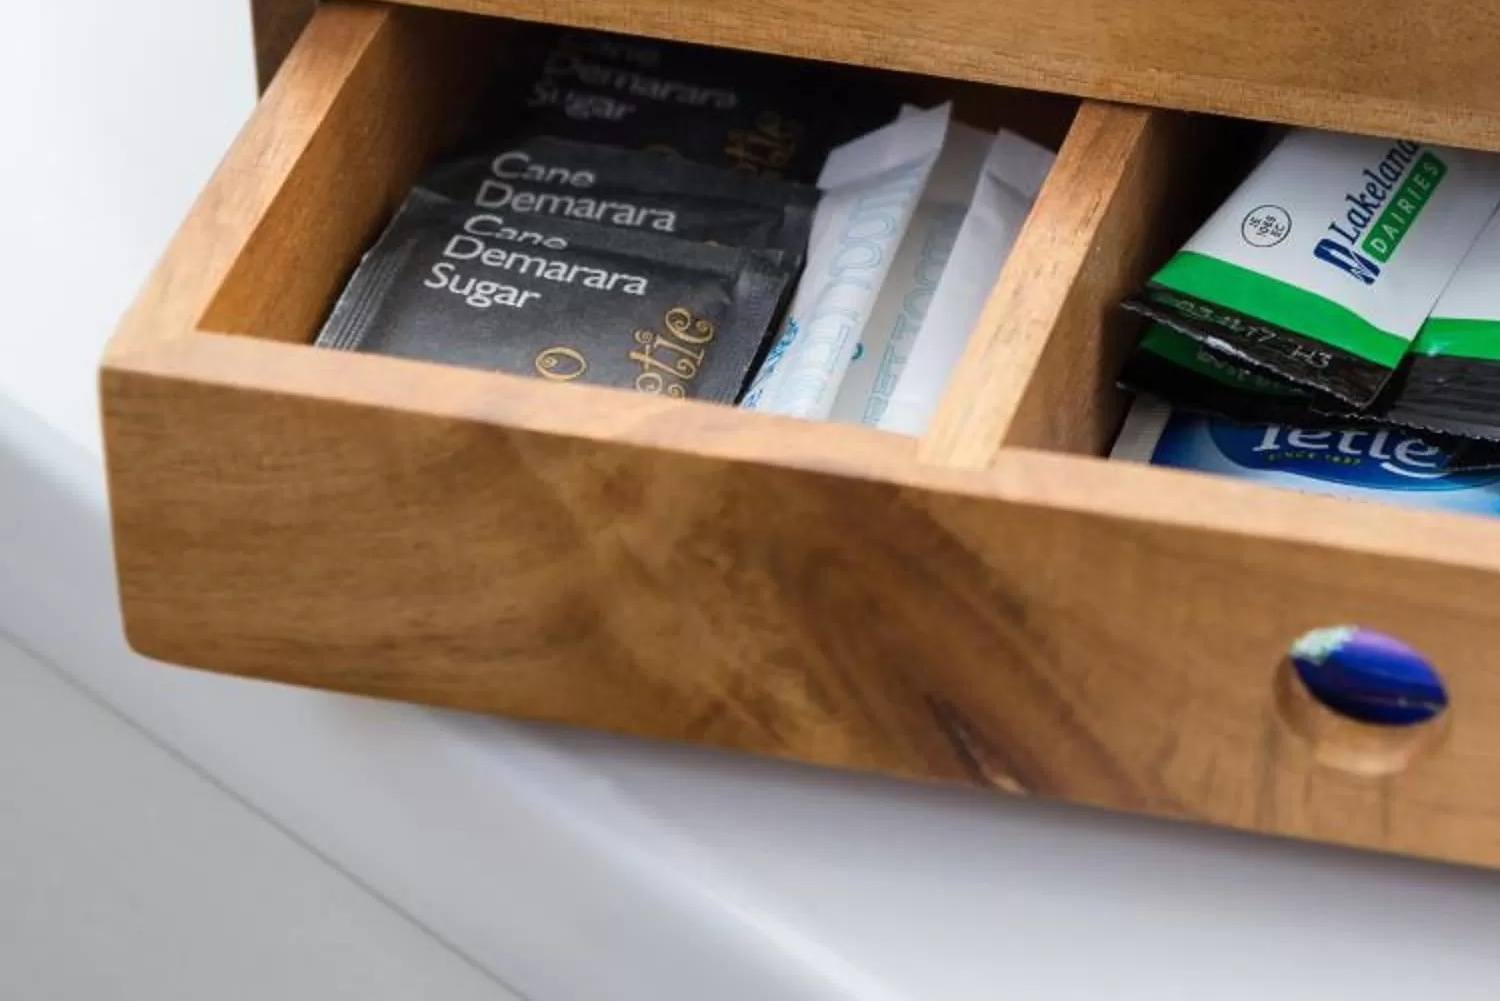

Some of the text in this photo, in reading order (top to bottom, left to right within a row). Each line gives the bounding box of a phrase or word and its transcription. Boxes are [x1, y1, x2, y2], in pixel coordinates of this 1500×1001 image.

[491, 150, 596, 189] Cane
[463, 214, 569, 249] Cane
[474, 179, 677, 233] Demarara
[1369, 161, 1439, 255] DAIRIES
[424, 262, 542, 309] Sugar
[443, 235, 648, 296] Demarara
[1252, 421, 1442, 472] Tetle
